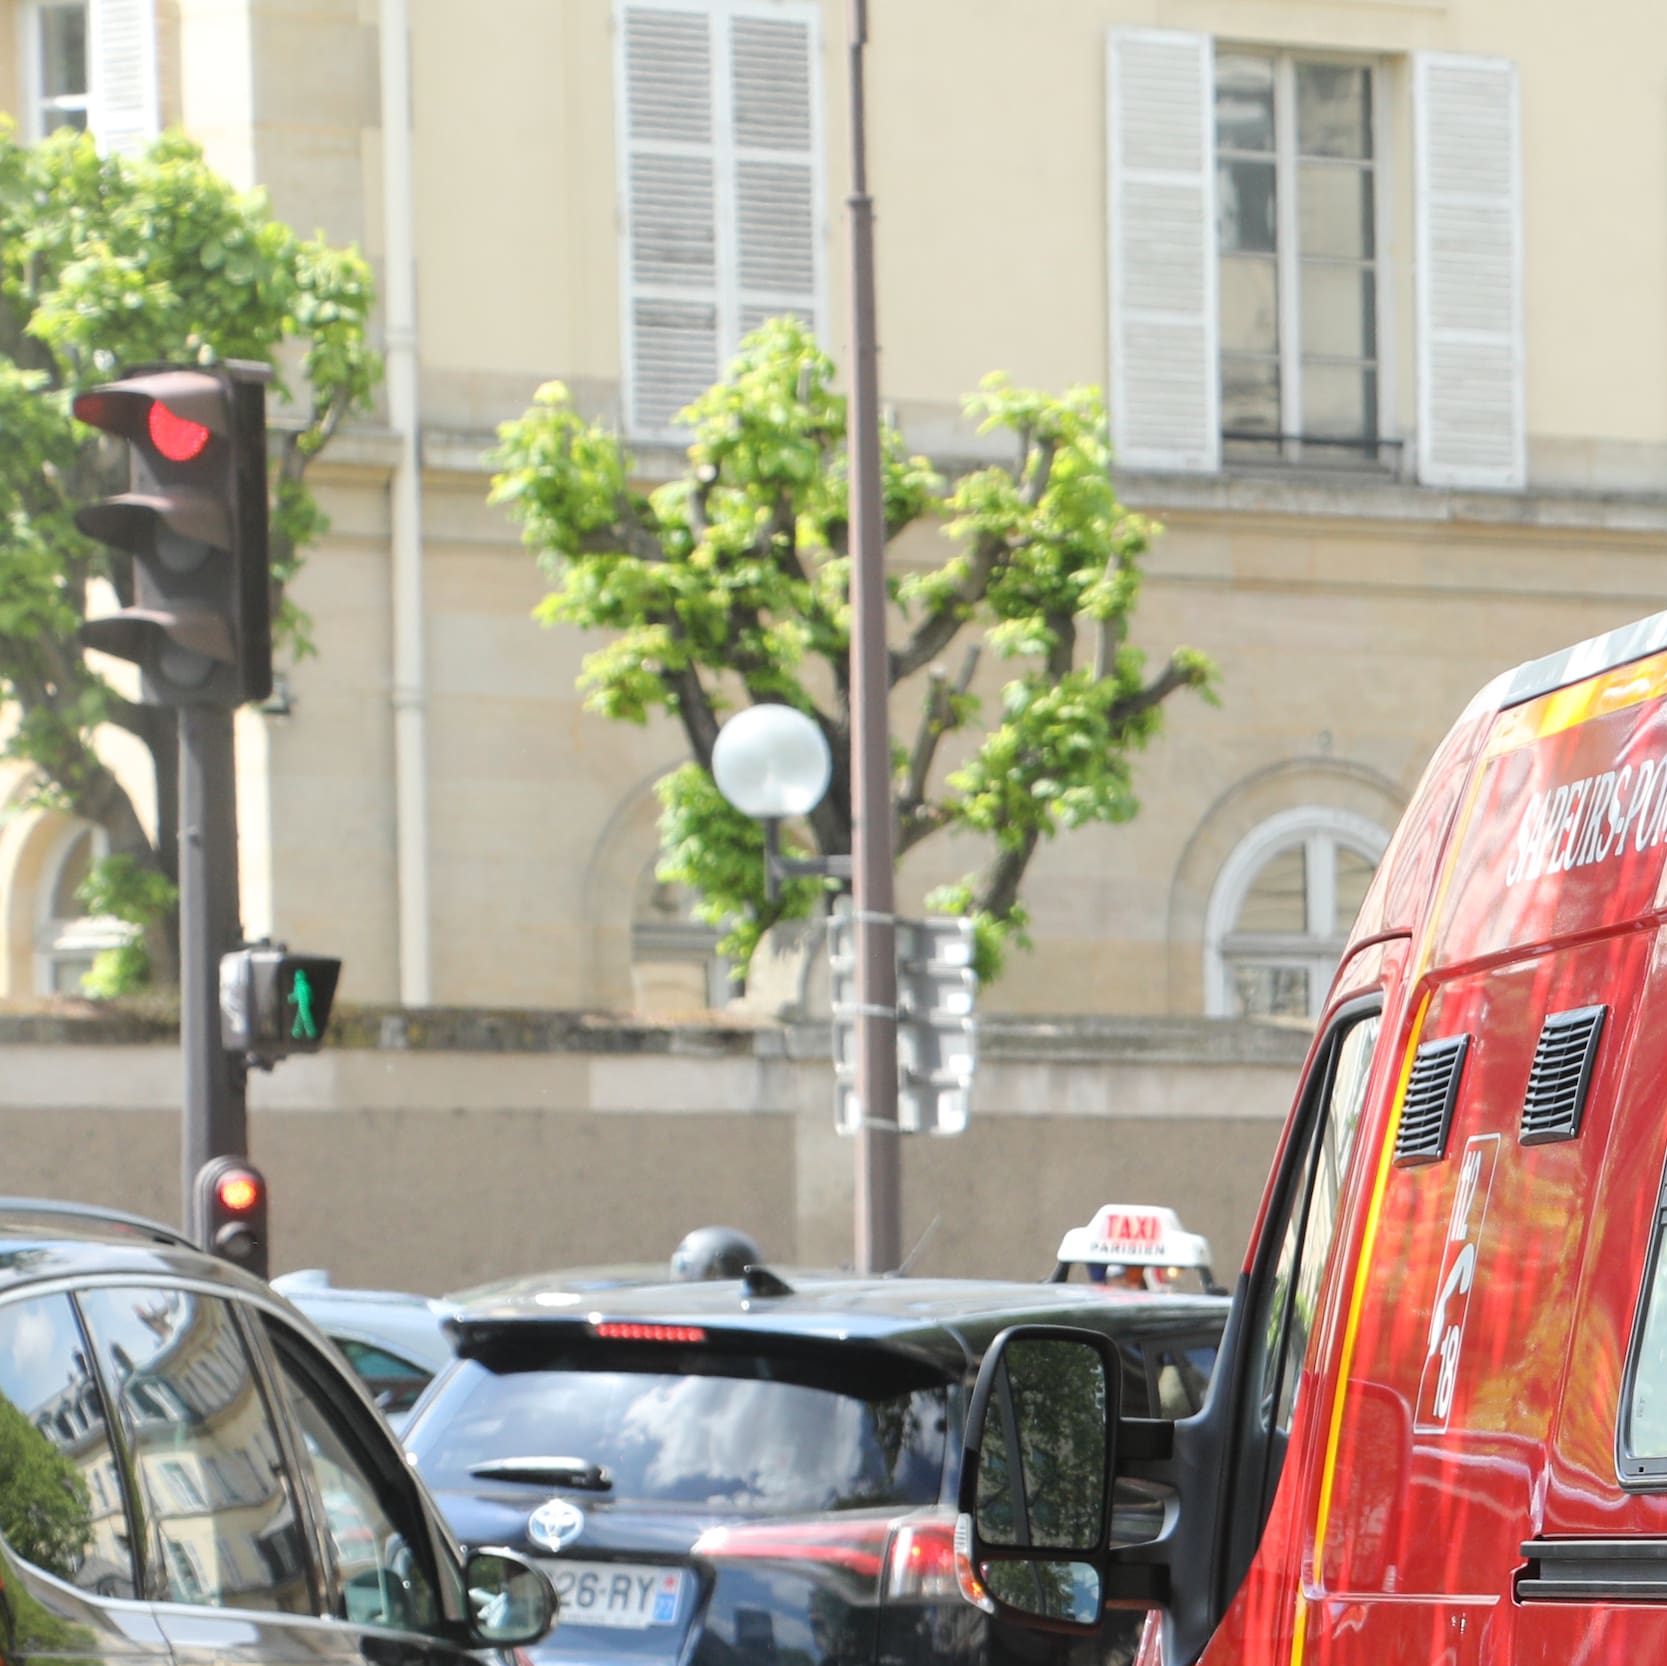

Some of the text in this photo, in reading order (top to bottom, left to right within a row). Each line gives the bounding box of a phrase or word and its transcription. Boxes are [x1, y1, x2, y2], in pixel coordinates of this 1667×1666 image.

[1107, 1214, 1161, 1241] TAXI
[1090, 1242, 1166, 1256] PARISIEN
[1433, 1325, 1460, 1418] 18
